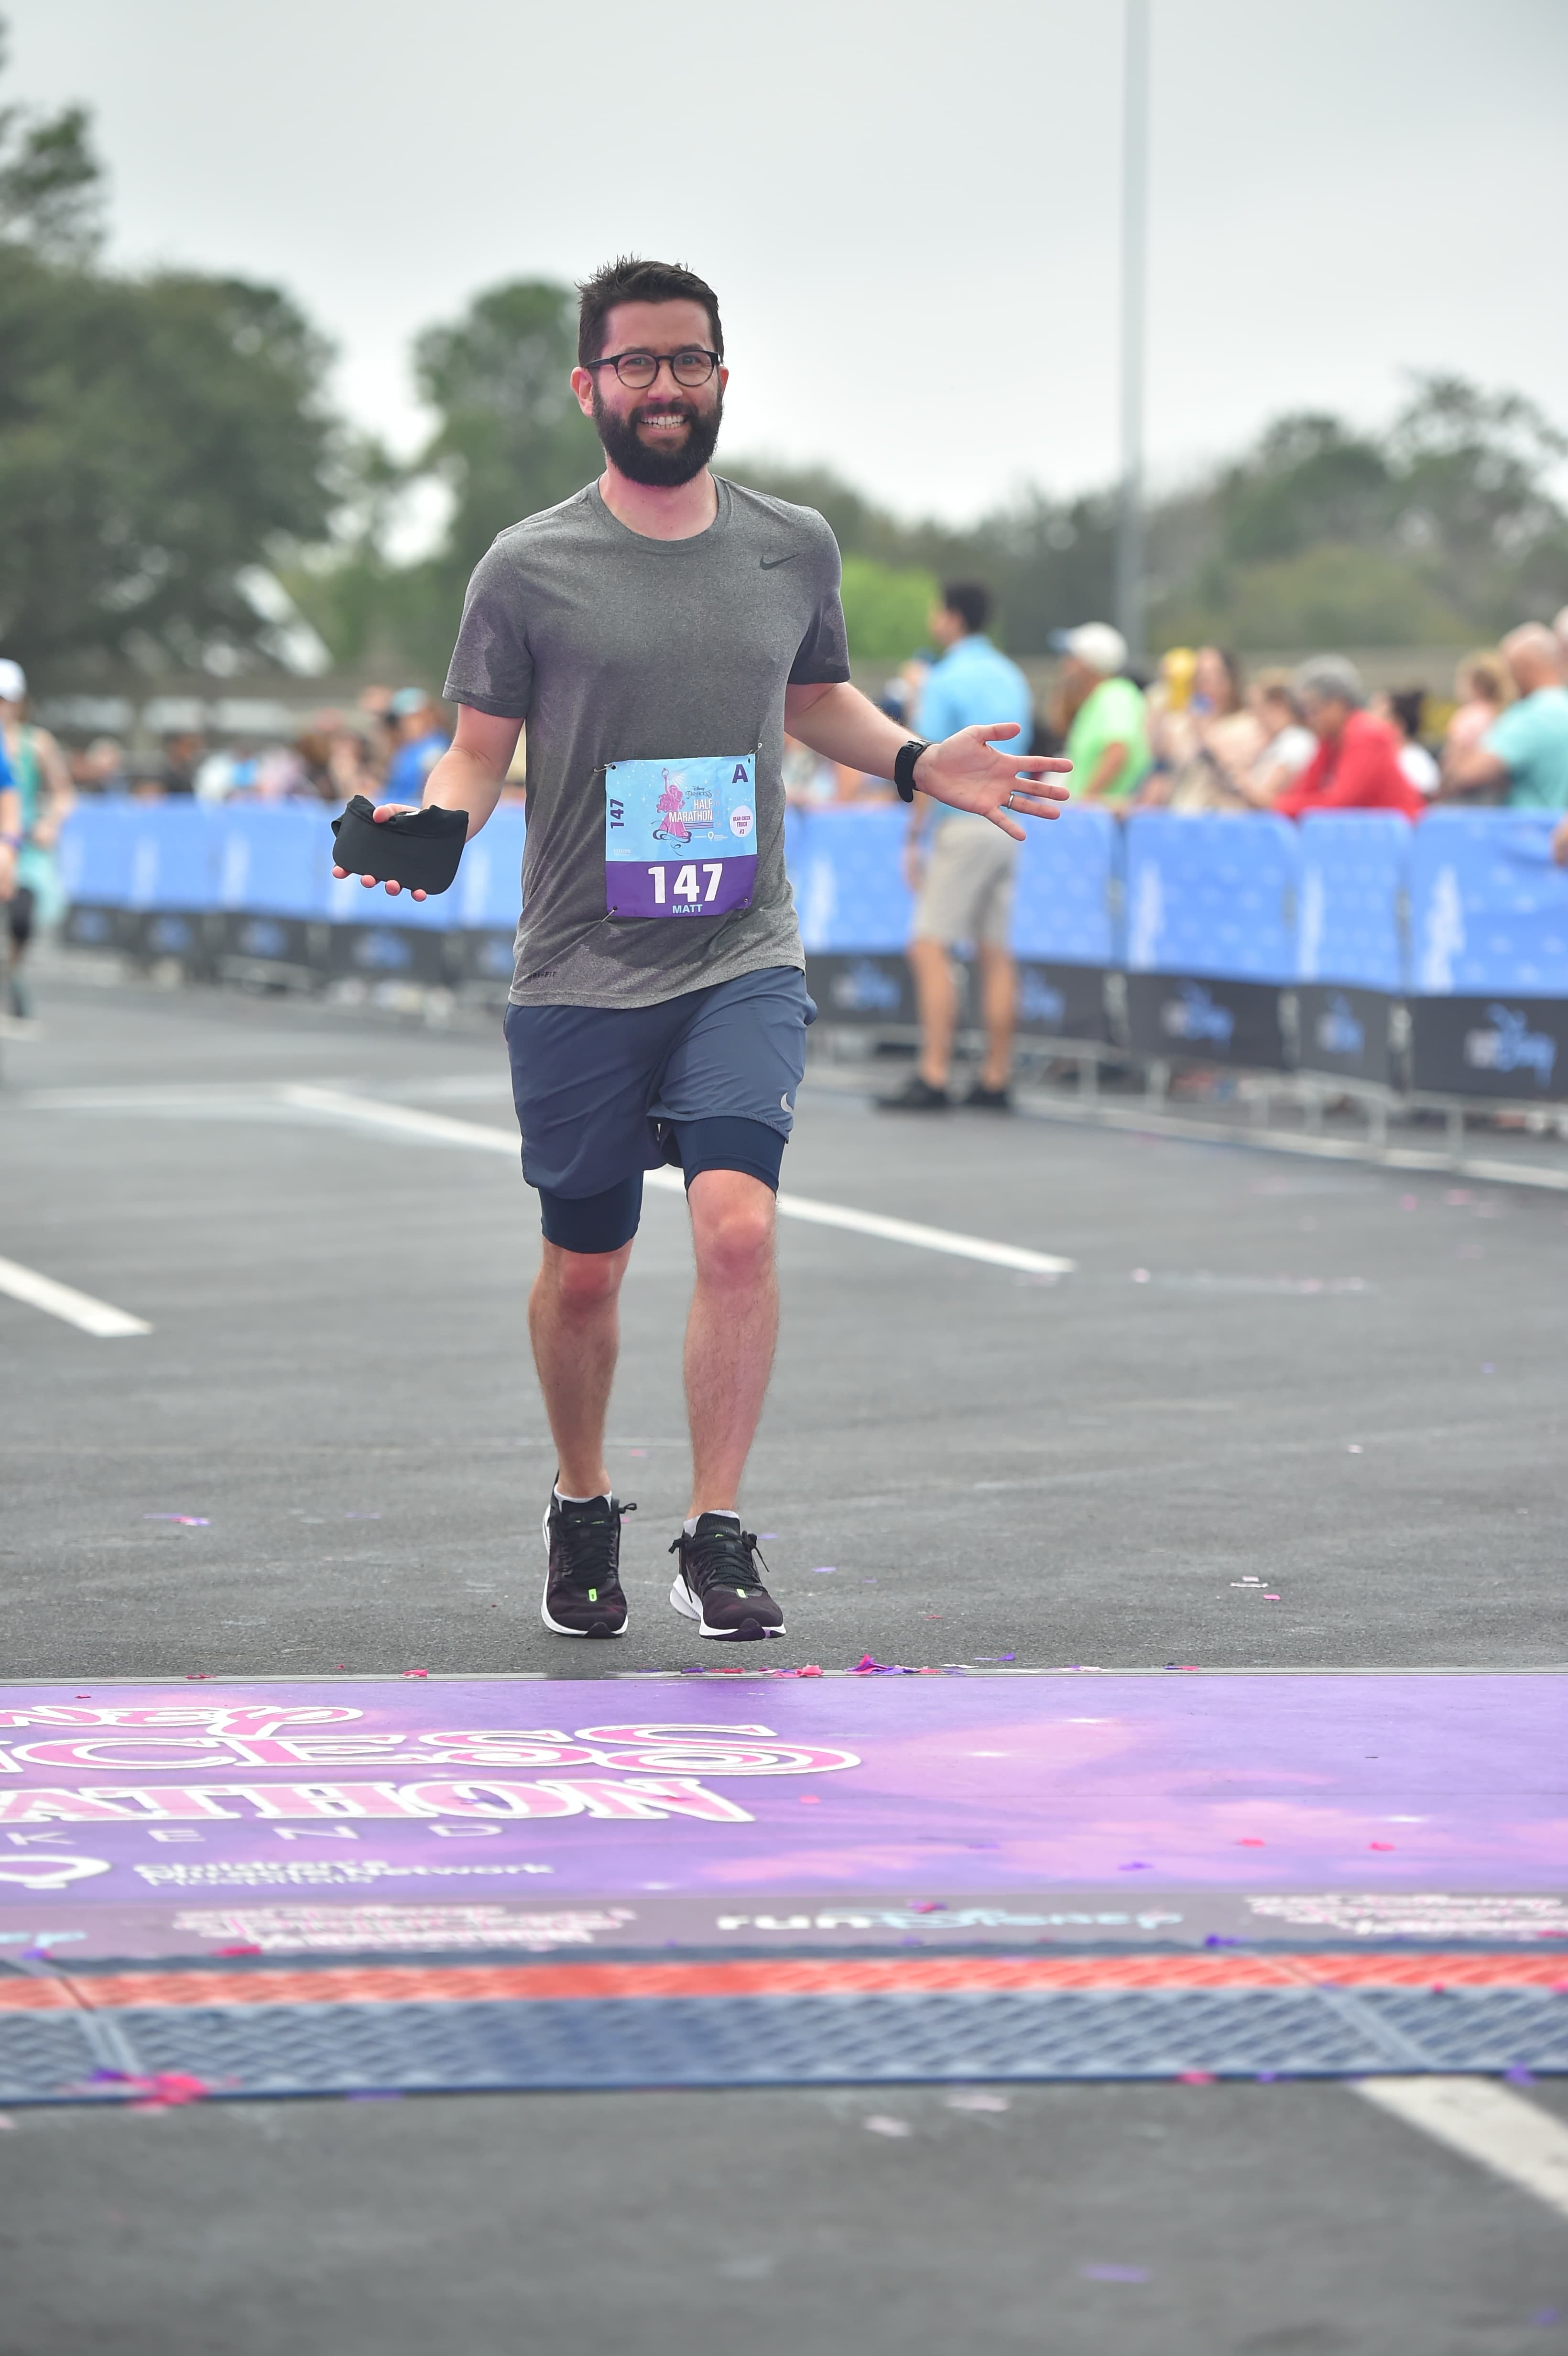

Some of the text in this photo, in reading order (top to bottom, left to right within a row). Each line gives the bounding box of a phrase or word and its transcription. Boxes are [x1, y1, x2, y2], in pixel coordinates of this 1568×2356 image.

[732, 764, 749, 784] A
[694, 798, 713, 810] HALF
[610, 798, 624, 829] 147
[669, 810, 713, 823] MARATHON
[648, 863, 723, 904] 147
[672, 904, 703, 914] MATT
